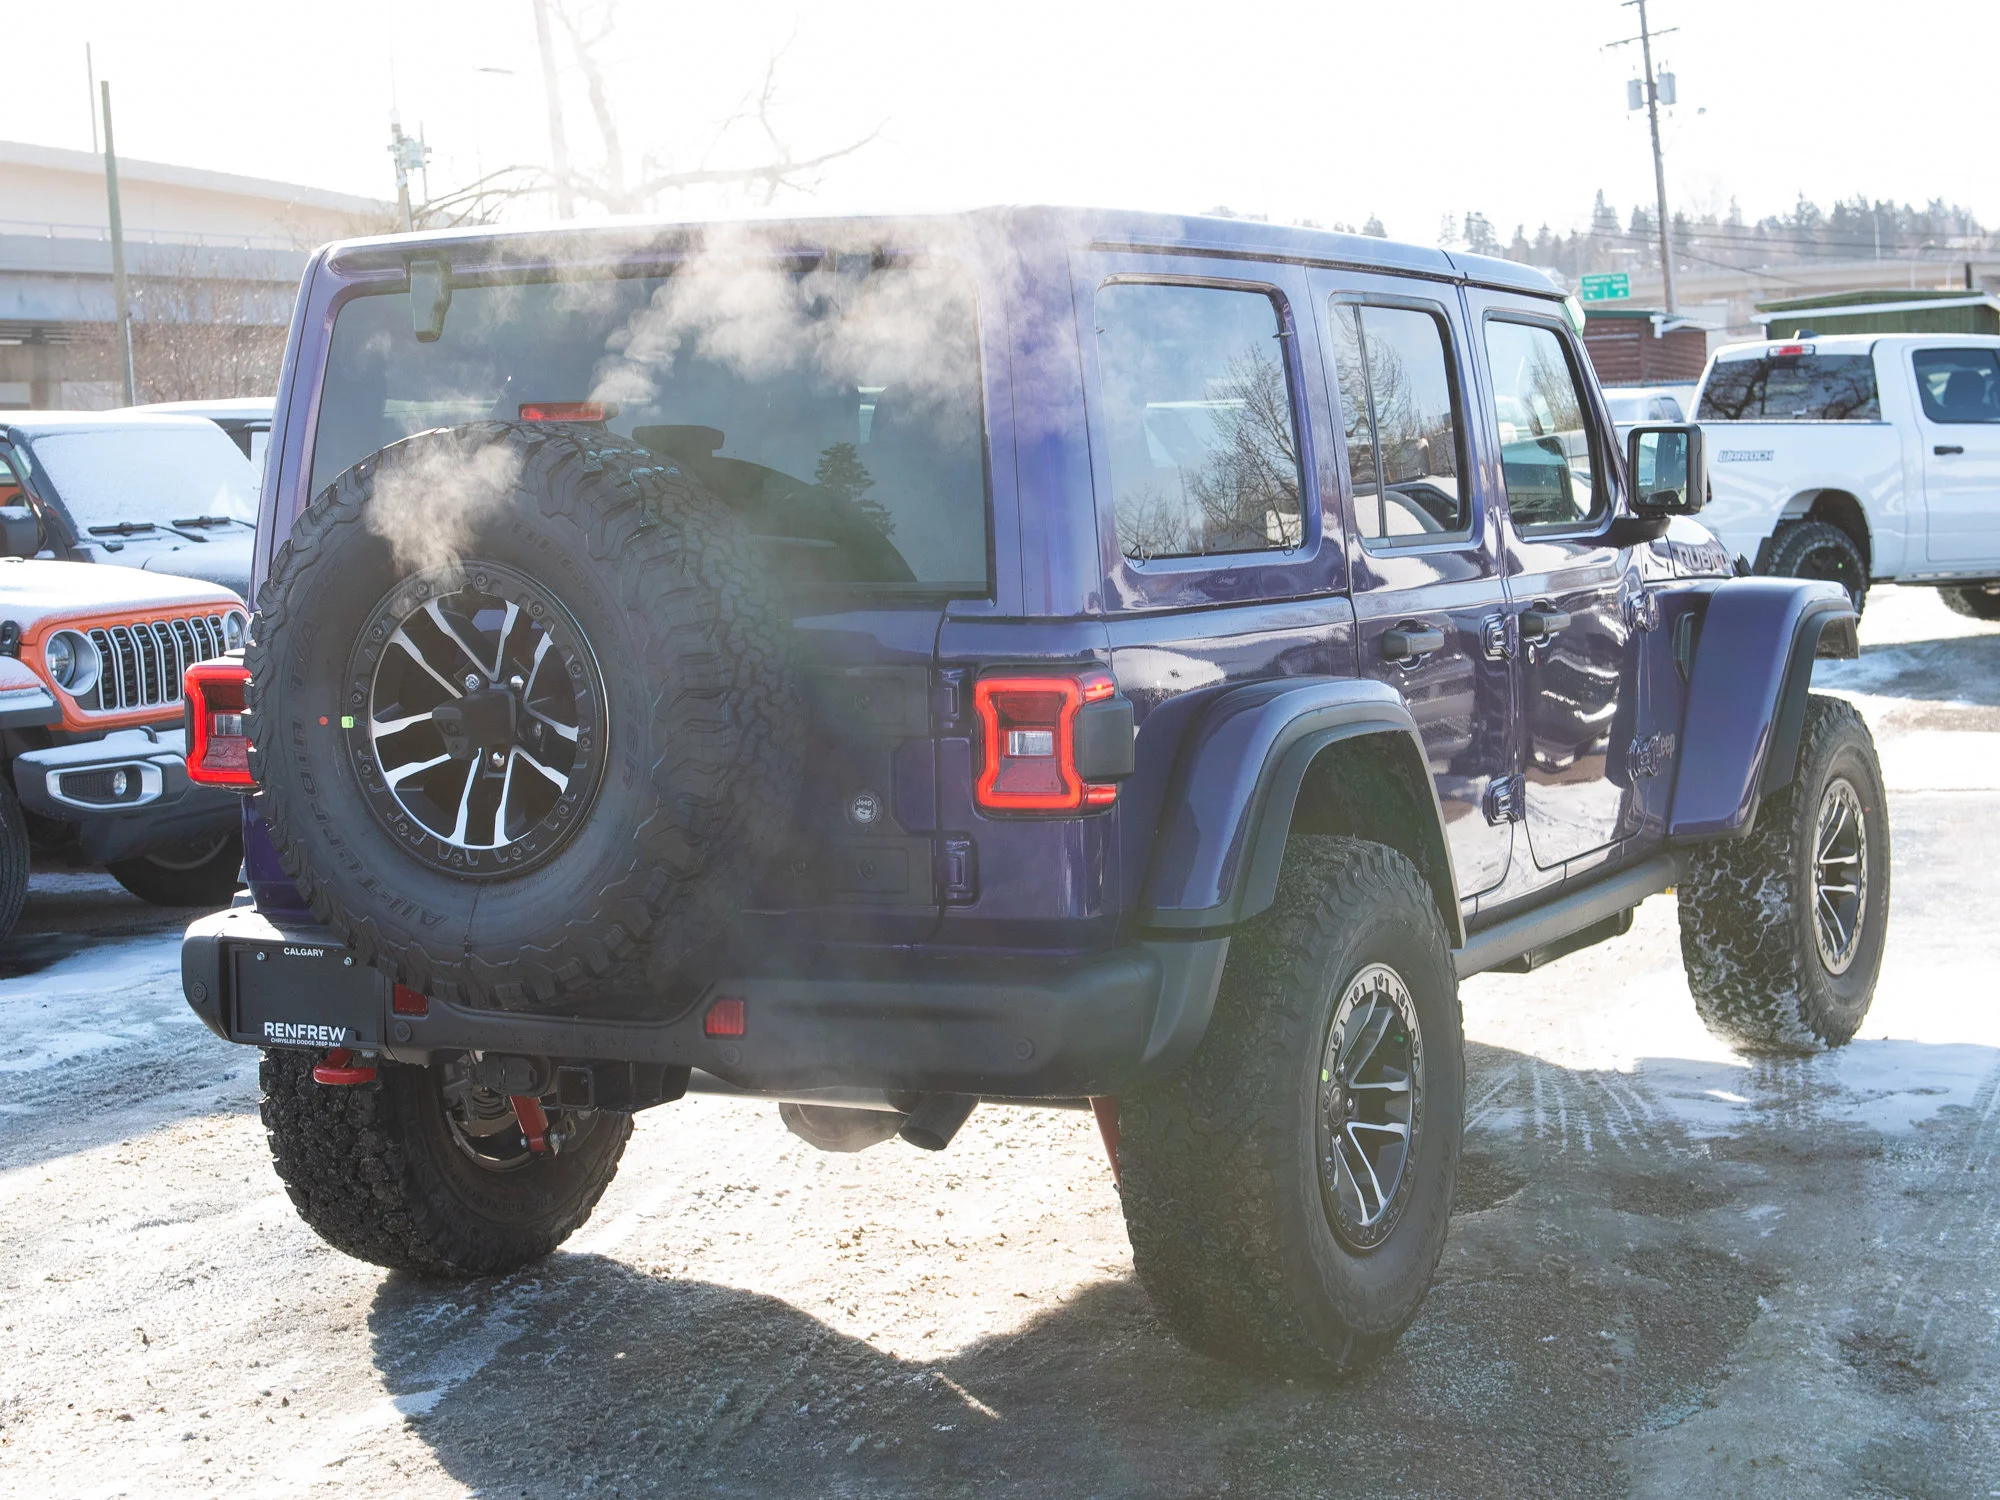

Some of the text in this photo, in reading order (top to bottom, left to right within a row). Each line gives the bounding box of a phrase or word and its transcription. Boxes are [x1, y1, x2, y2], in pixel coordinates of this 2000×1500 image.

[1717, 449, 1775, 464] WARLOCK
[856, 798, 872, 807] Jeep
[283, 947, 324, 957] CALGARY
[264, 1022, 346, 1041] RENFREW
[270, 1037, 296, 1045] CHRYSLER
